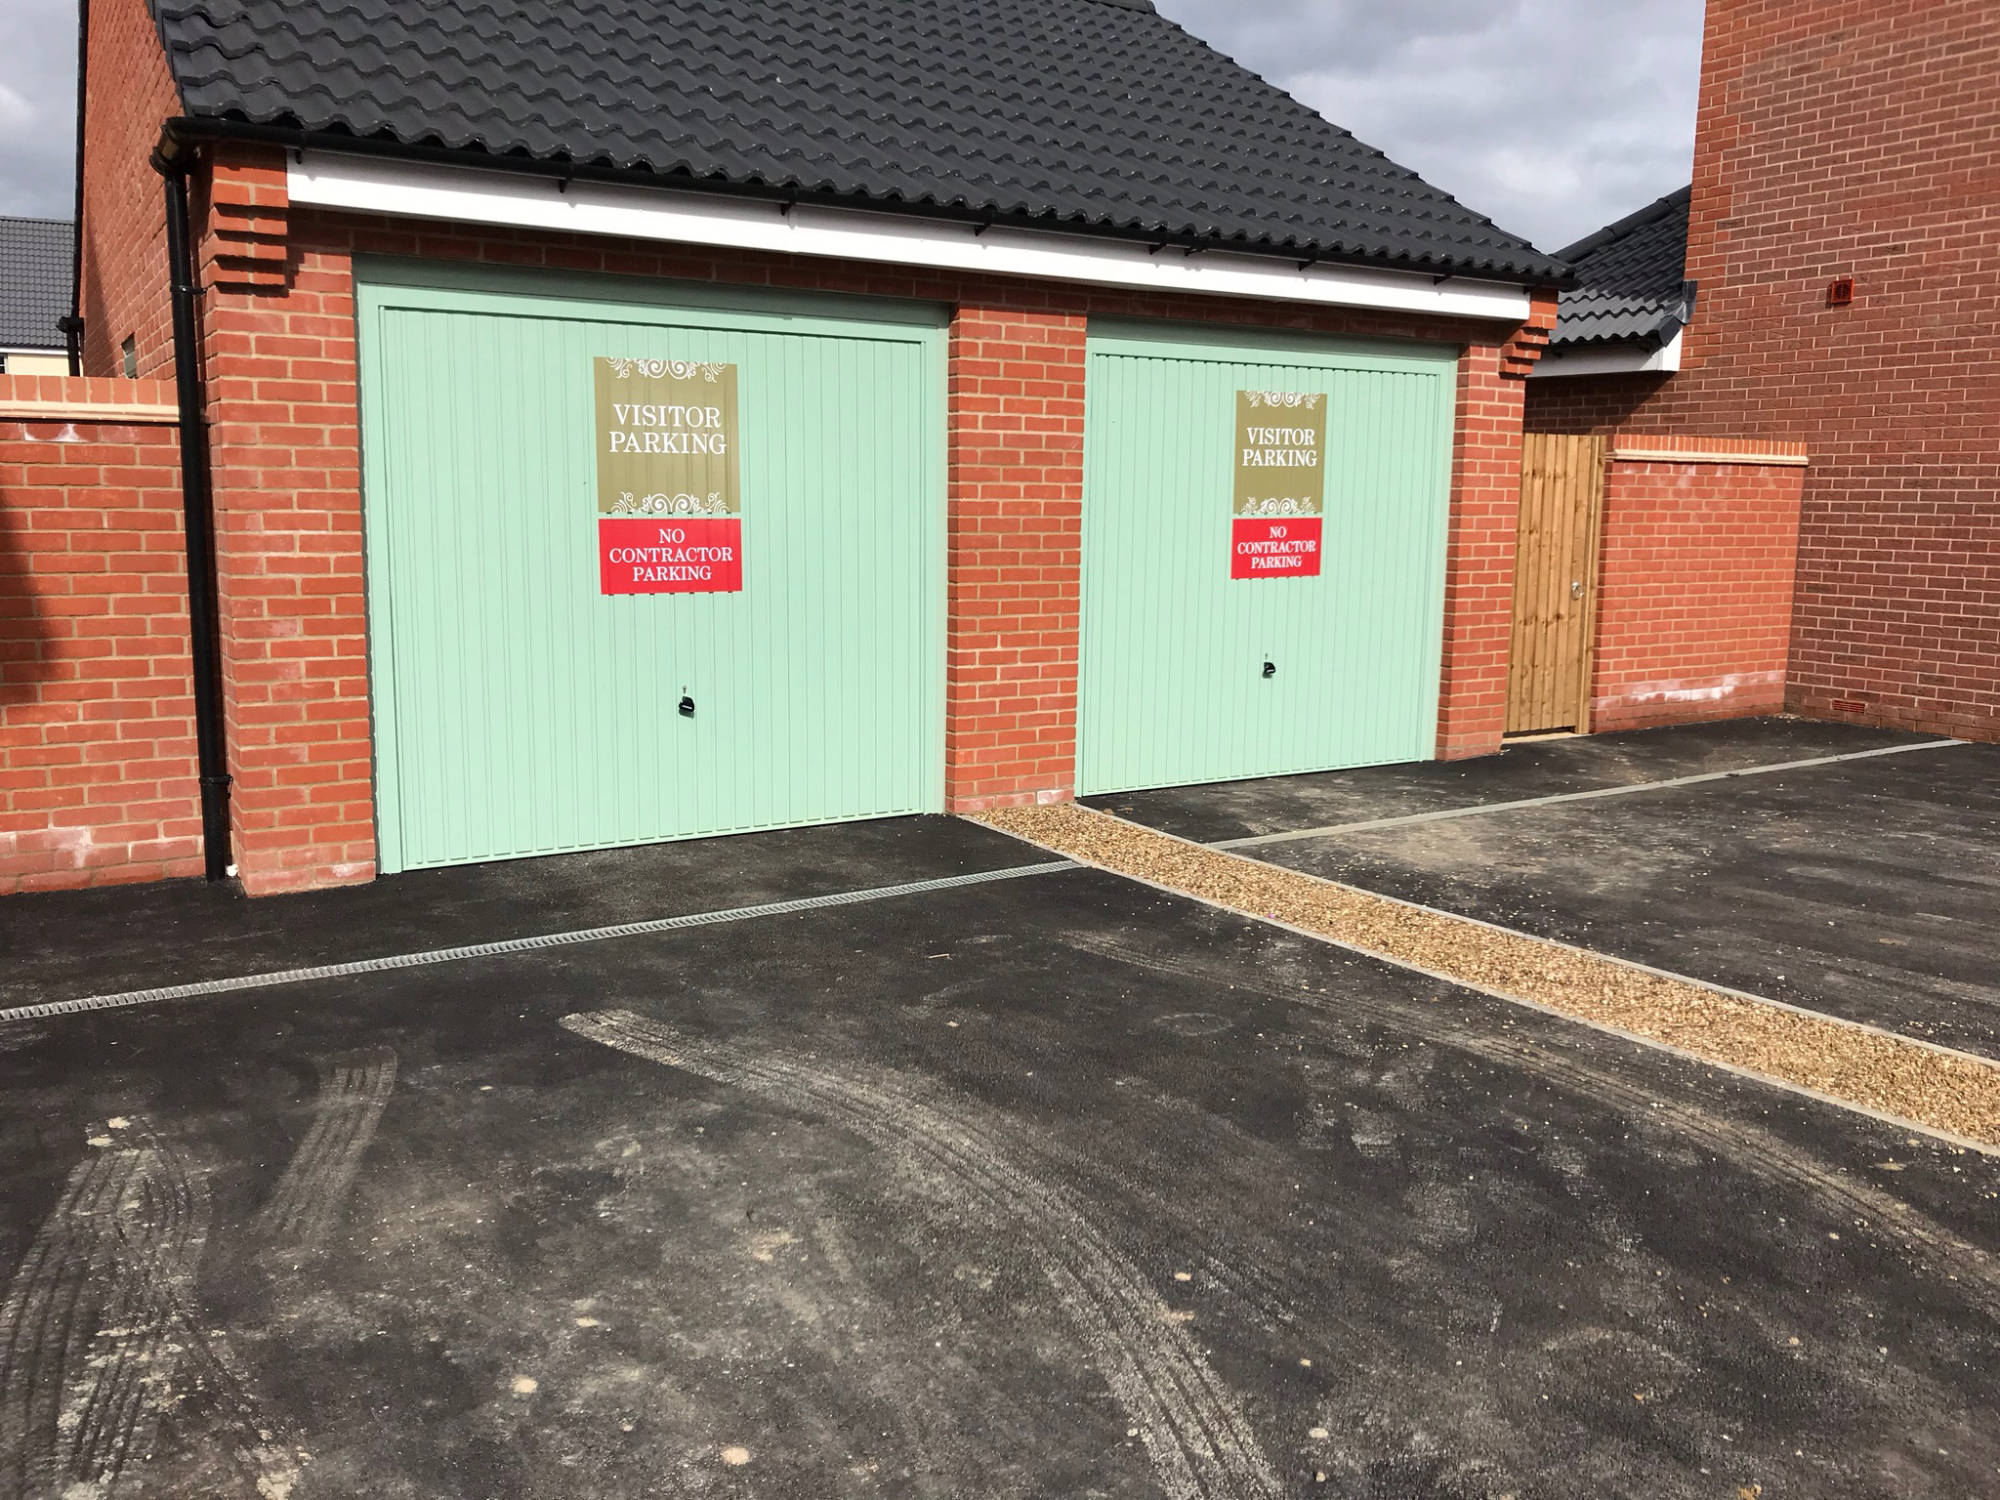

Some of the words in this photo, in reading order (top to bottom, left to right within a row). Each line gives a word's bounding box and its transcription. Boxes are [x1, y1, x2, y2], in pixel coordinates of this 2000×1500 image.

[613, 403, 721, 428] VISITOR
[609, 431, 726, 455] PARKING
[1247, 426, 1315, 446] VISITOR
[1242, 448, 1318, 467] PARKING
[658, 528, 685, 544] NO
[1269, 526, 1288, 539] NO
[609, 546, 733, 563] CONTRACTOR
[1237, 540, 1316, 555] CONTRACTOR
[1251, 555, 1302, 570] PARKING
[633, 565, 712, 582] PARKING
